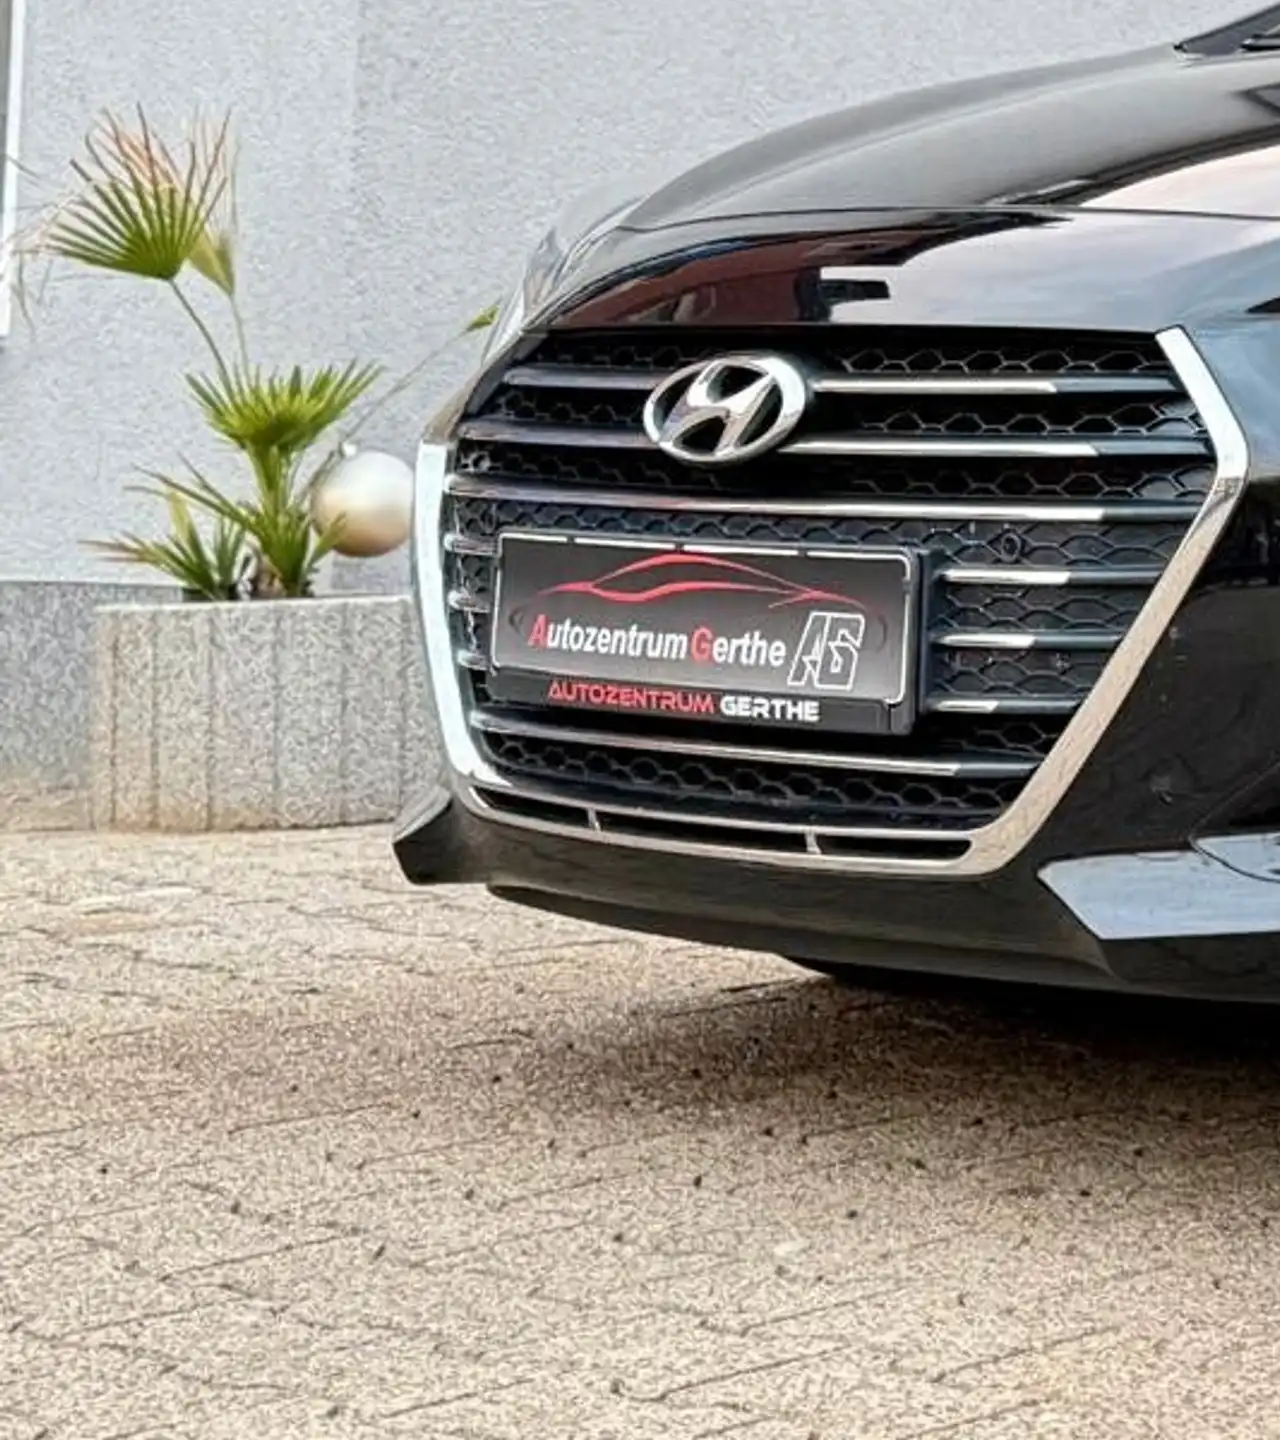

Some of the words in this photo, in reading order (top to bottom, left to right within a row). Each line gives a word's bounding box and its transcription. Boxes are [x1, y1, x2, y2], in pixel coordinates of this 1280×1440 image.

[528, 613, 687, 661] Autozentrum
[690, 627, 787, 668] Gerthe
[548, 680, 716, 714] AUTOZENTRUM
[719, 694, 821, 723] GERTHE
